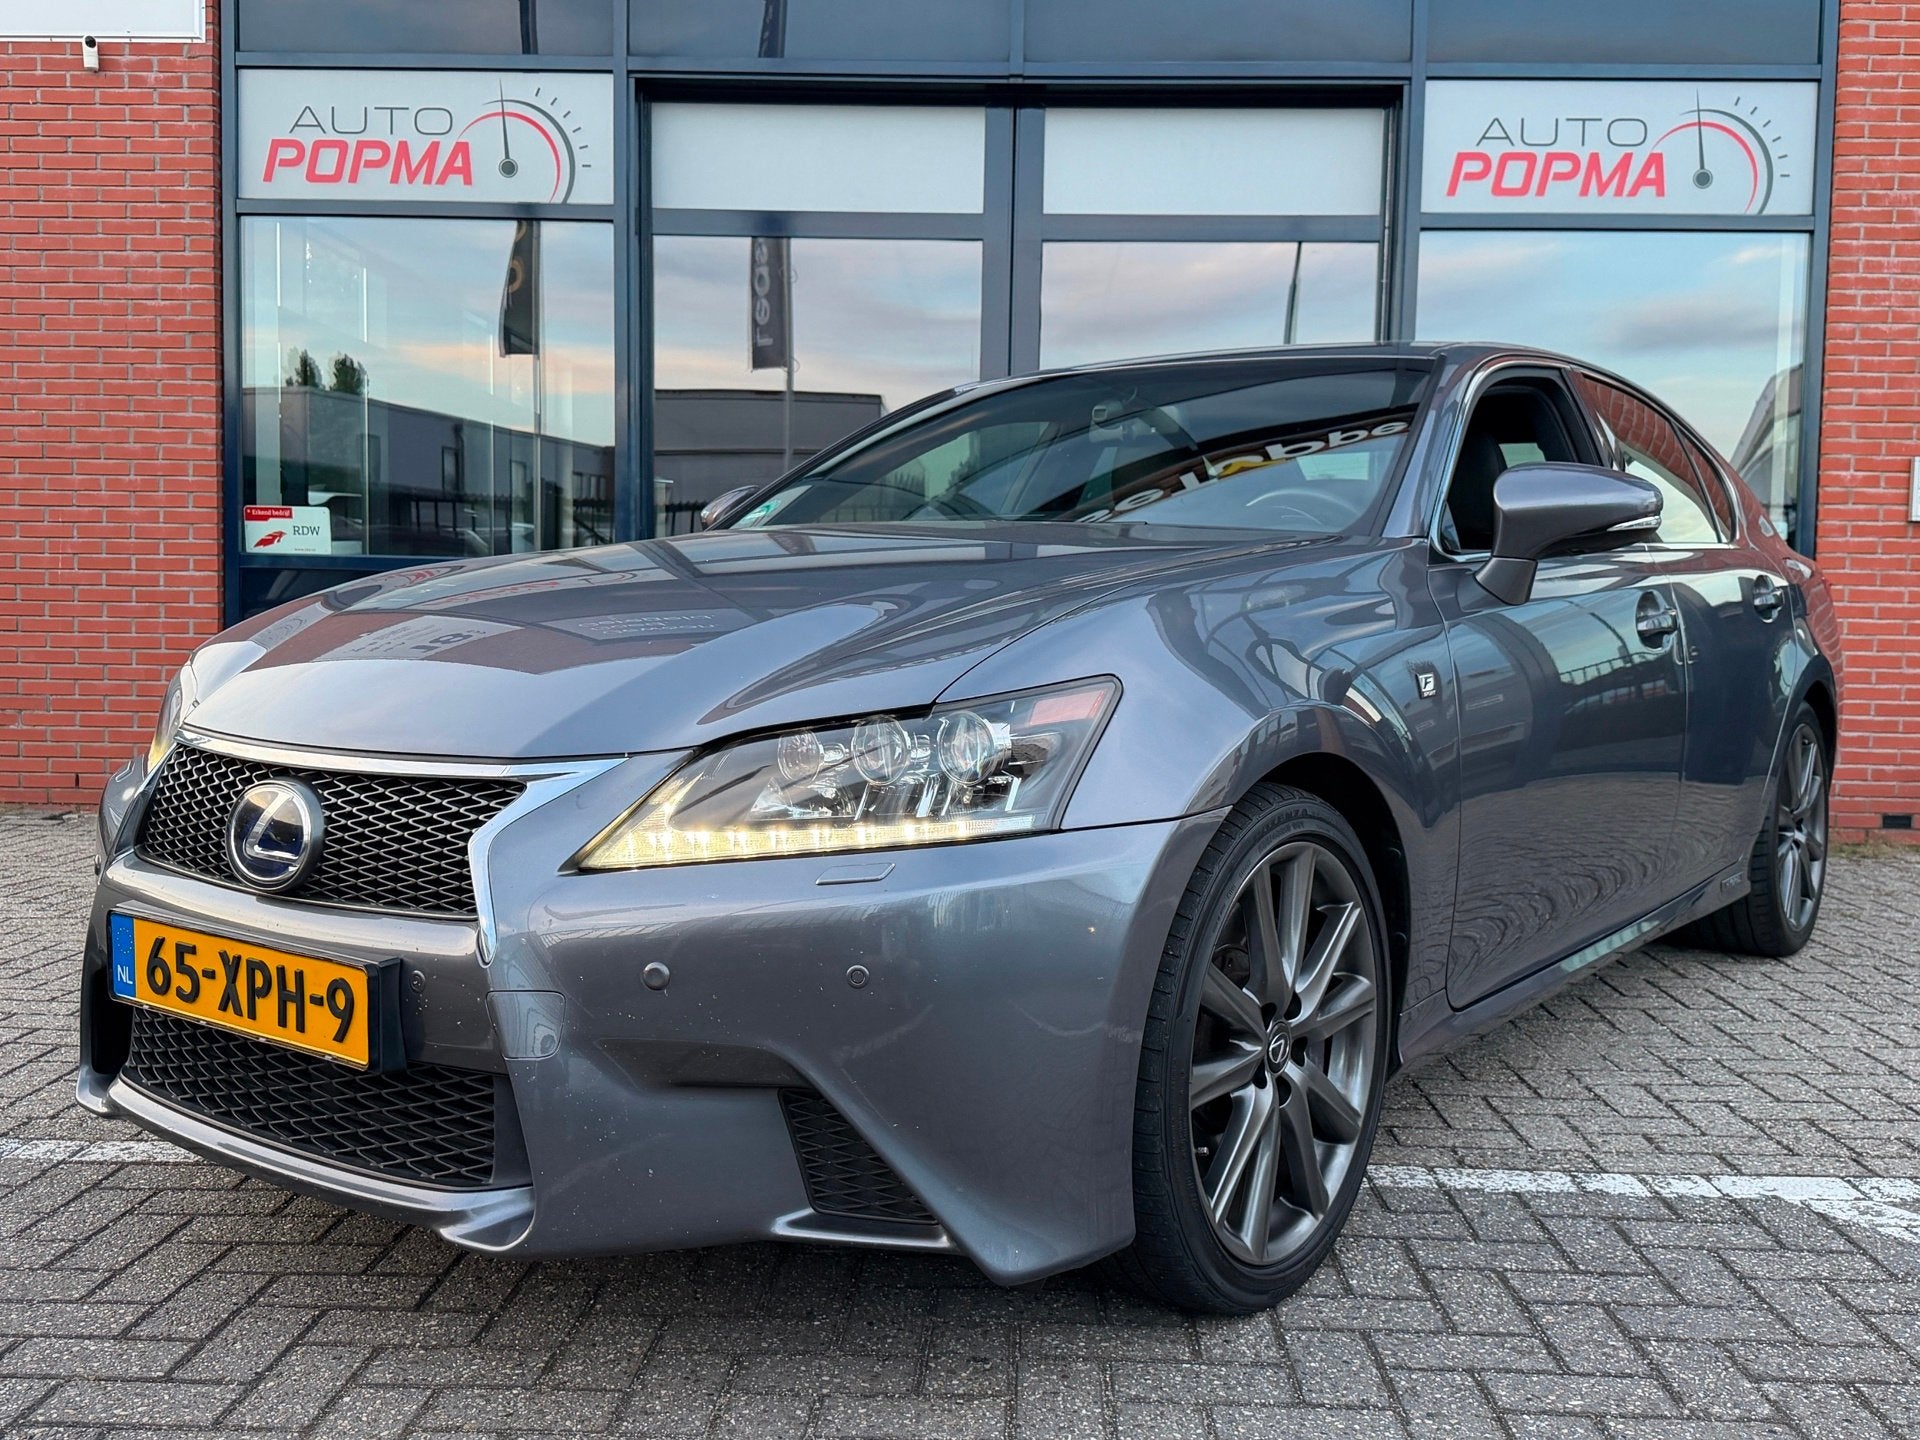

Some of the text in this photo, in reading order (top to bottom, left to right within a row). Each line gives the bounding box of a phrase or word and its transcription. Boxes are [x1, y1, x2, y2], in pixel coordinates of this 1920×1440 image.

[289, 105, 453, 136] AUTO
[1476, 117, 1648, 147] AUTO
[262, 138, 473, 186] POPMA
[1446, 151, 1665, 197] POPMA
[293, 525, 320, 536] RDW
[117, 964, 134, 985] NL
[146, 936, 355, 1043] 65-XPH-9
